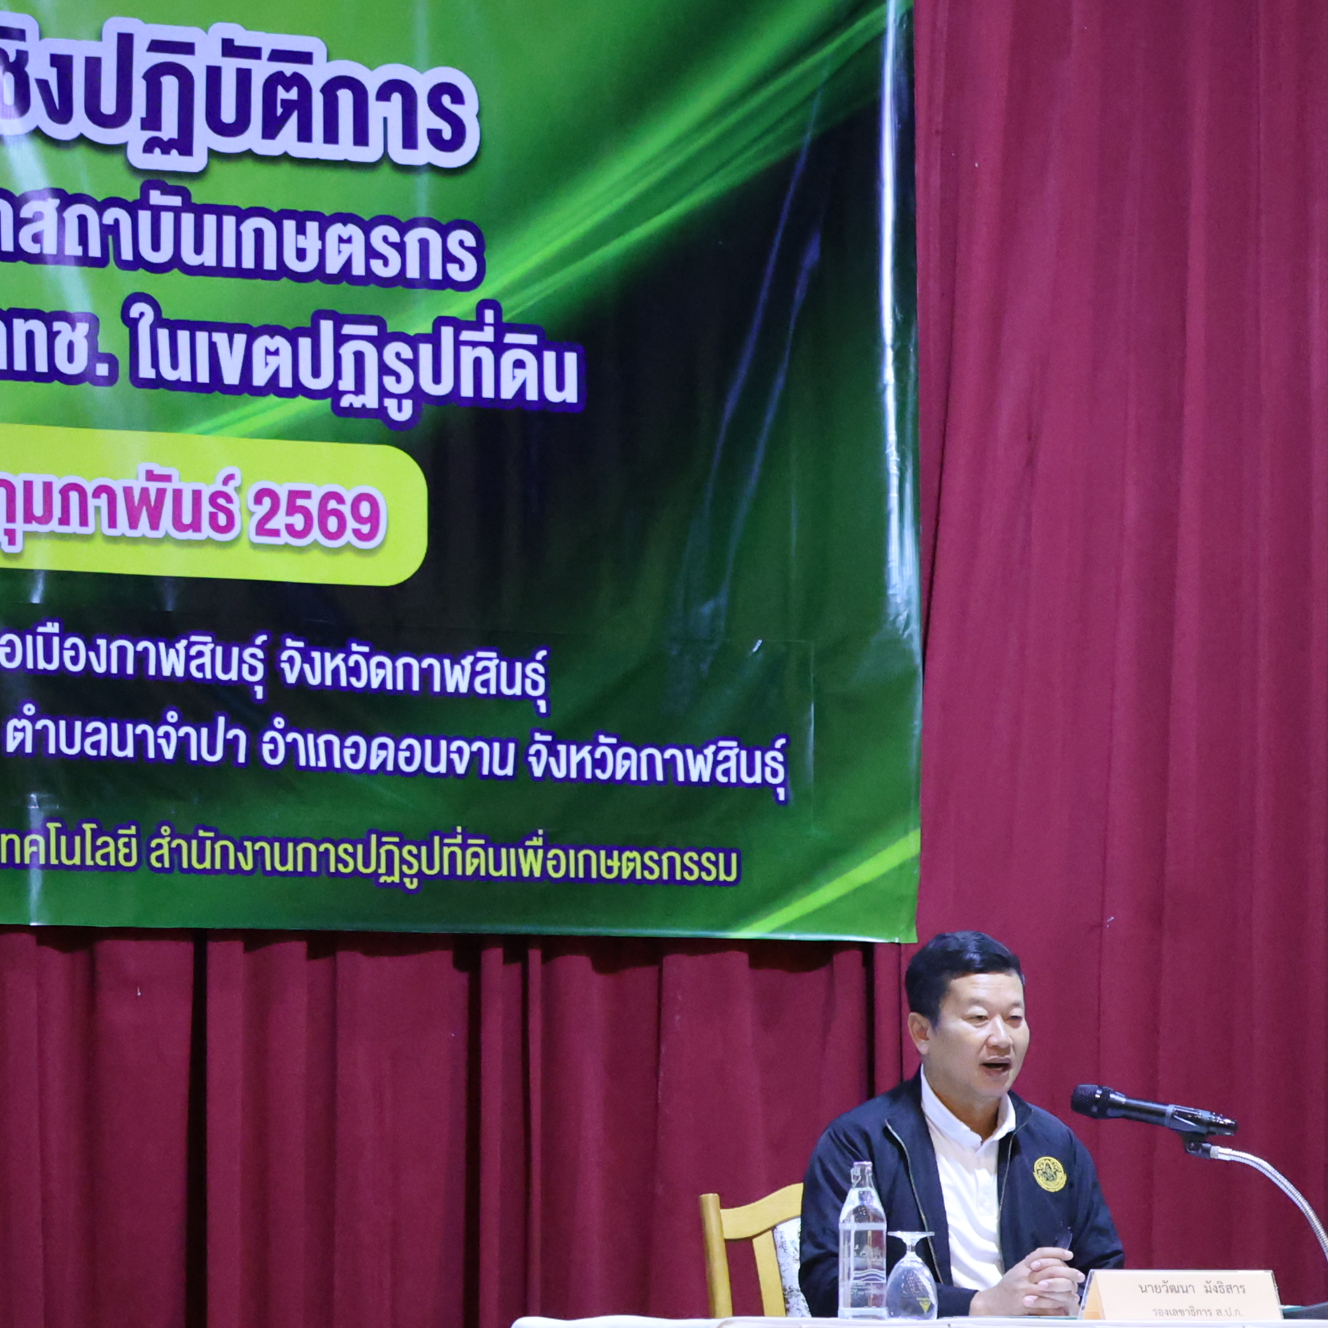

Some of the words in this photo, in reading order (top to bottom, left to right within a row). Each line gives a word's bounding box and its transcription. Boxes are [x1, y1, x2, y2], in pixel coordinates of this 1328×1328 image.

[0, 316, 109, 376] ทช.
[130, 302, 578, 422] ในเขตปฏิรูปที่ดิน
[253, 487, 382, 543] 2569
[0, 622, 268, 699] อเมืองกาฬสินธุ์
[280, 637, 547, 713] จังหวัดกาฬสินธุ์
[6, 703, 247, 763] ตำบลนาจำปา
[262, 717, 516, 776] อำเภอดอนจาน
[528, 732, 787, 801] จังหวัดกาฬสินธุ์
[0, 823, 138, 868] ทคโนโลยี
[150, 825, 738, 889] สำนักงานการปฏิรูปที่ดินเพื่อเกษตรกรรม
[1138, 1279, 1196, 1295] นายวัฒนา
